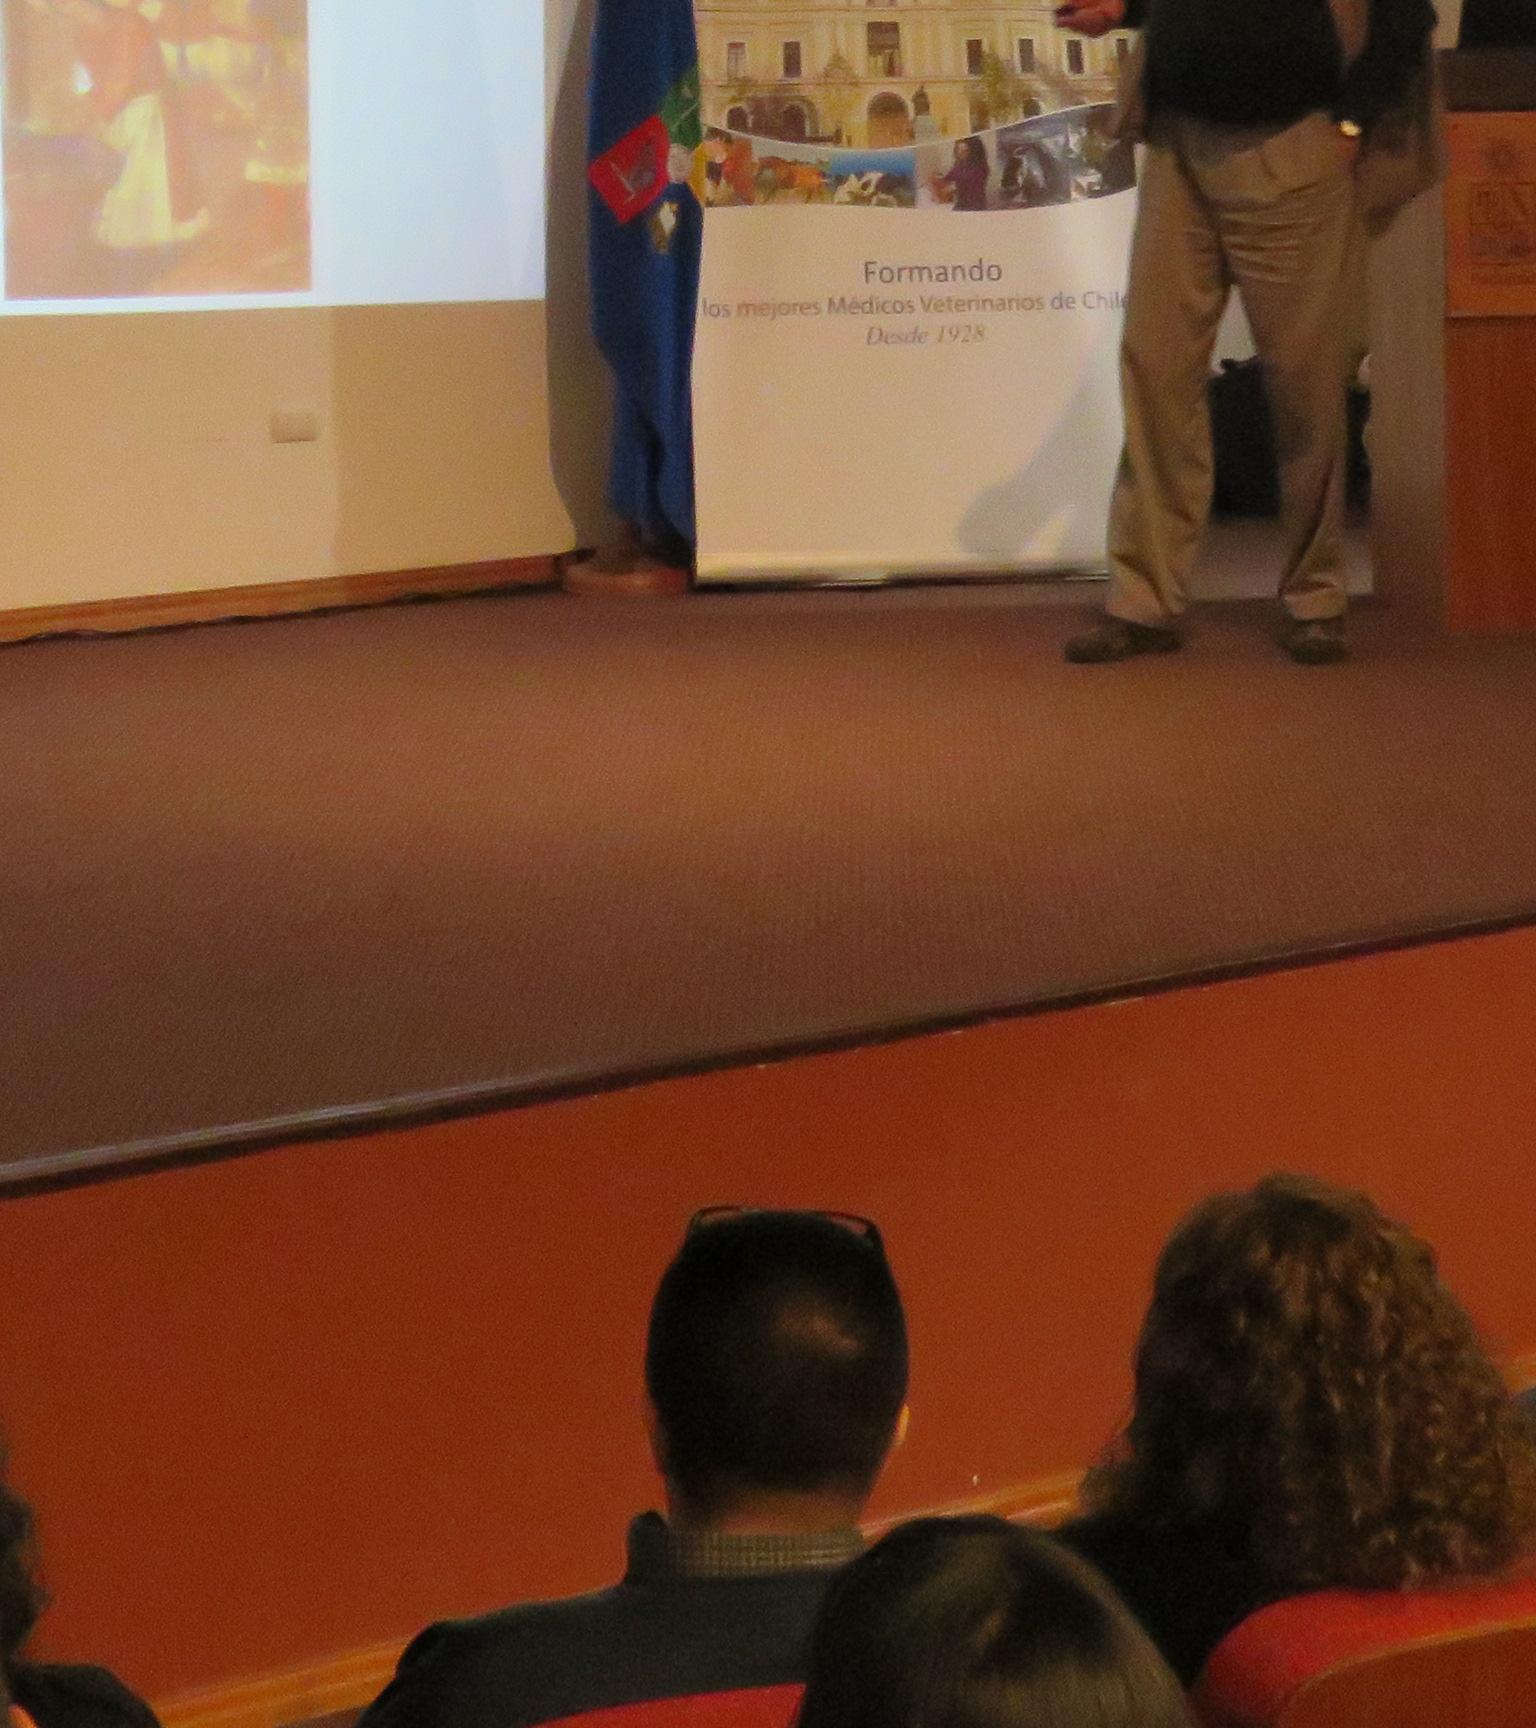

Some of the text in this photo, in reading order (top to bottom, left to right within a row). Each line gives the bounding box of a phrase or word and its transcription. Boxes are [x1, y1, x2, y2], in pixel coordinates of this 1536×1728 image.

[863, 258, 1003, 284] Formando
[701, 298, 731, 319] los
[736, 299, 821, 321] mejores
[827, 295, 915, 315] Médicos
[920, 293, 1045, 313] Veterinarios
[1049, 291, 1077, 311] de
[865, 323, 987, 346] Desde 1928
